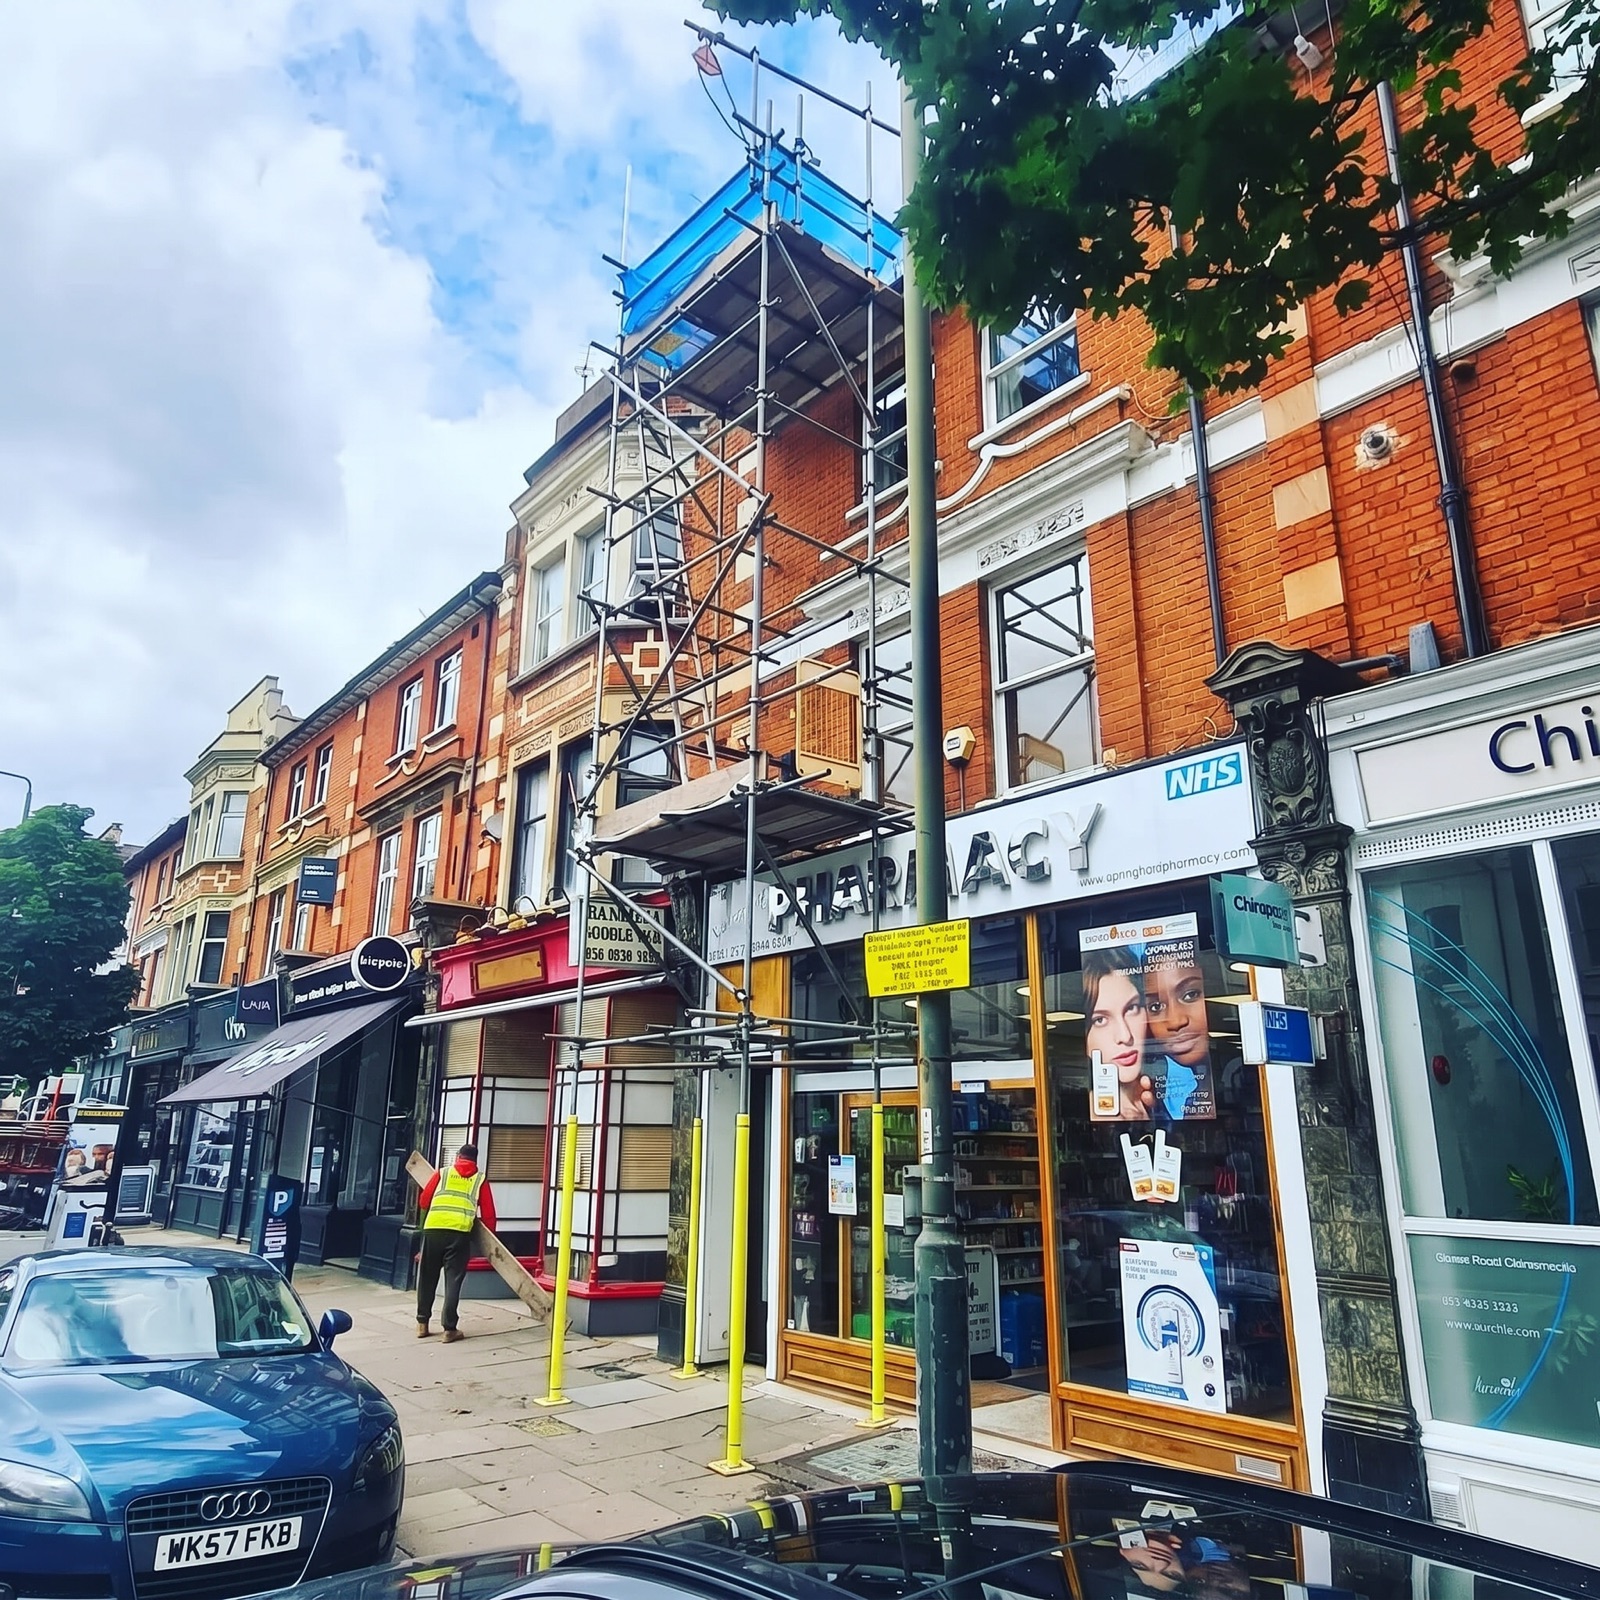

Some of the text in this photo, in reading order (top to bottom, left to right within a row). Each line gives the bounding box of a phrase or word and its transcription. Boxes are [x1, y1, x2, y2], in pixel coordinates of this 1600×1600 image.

[1168, 754, 1239, 799] NHS
[1267, 1011, 1287, 1029] NHS
[273, 1191, 288, 1213] P
[168, 1521, 293, 1564] WK57 FKB
